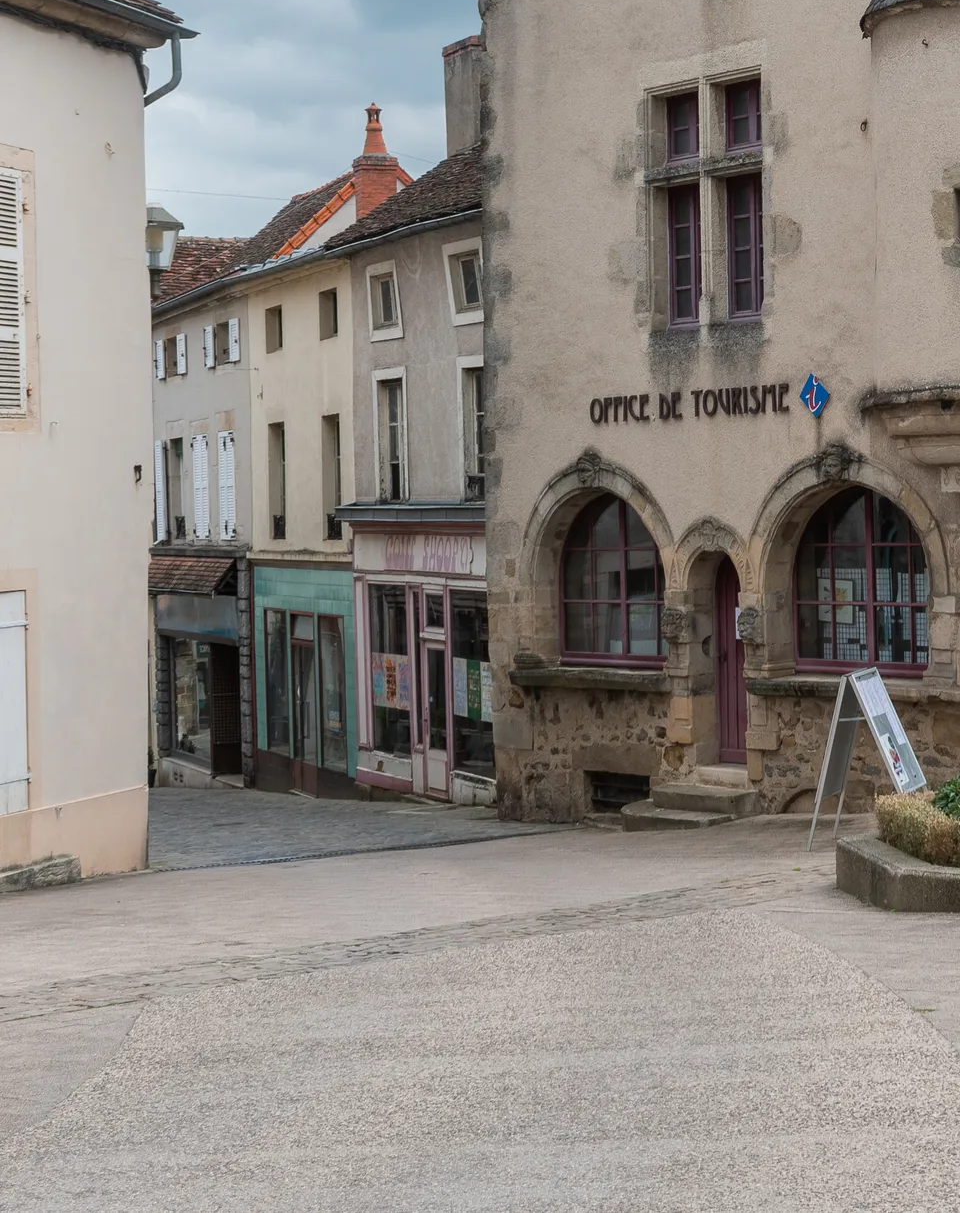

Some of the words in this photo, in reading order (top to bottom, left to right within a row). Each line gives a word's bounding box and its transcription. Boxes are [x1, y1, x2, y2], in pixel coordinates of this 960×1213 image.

[589, 393, 650, 424] OFFICE
[658, 391, 683, 420] DE
[690, 383, 790, 418] TOURISME
